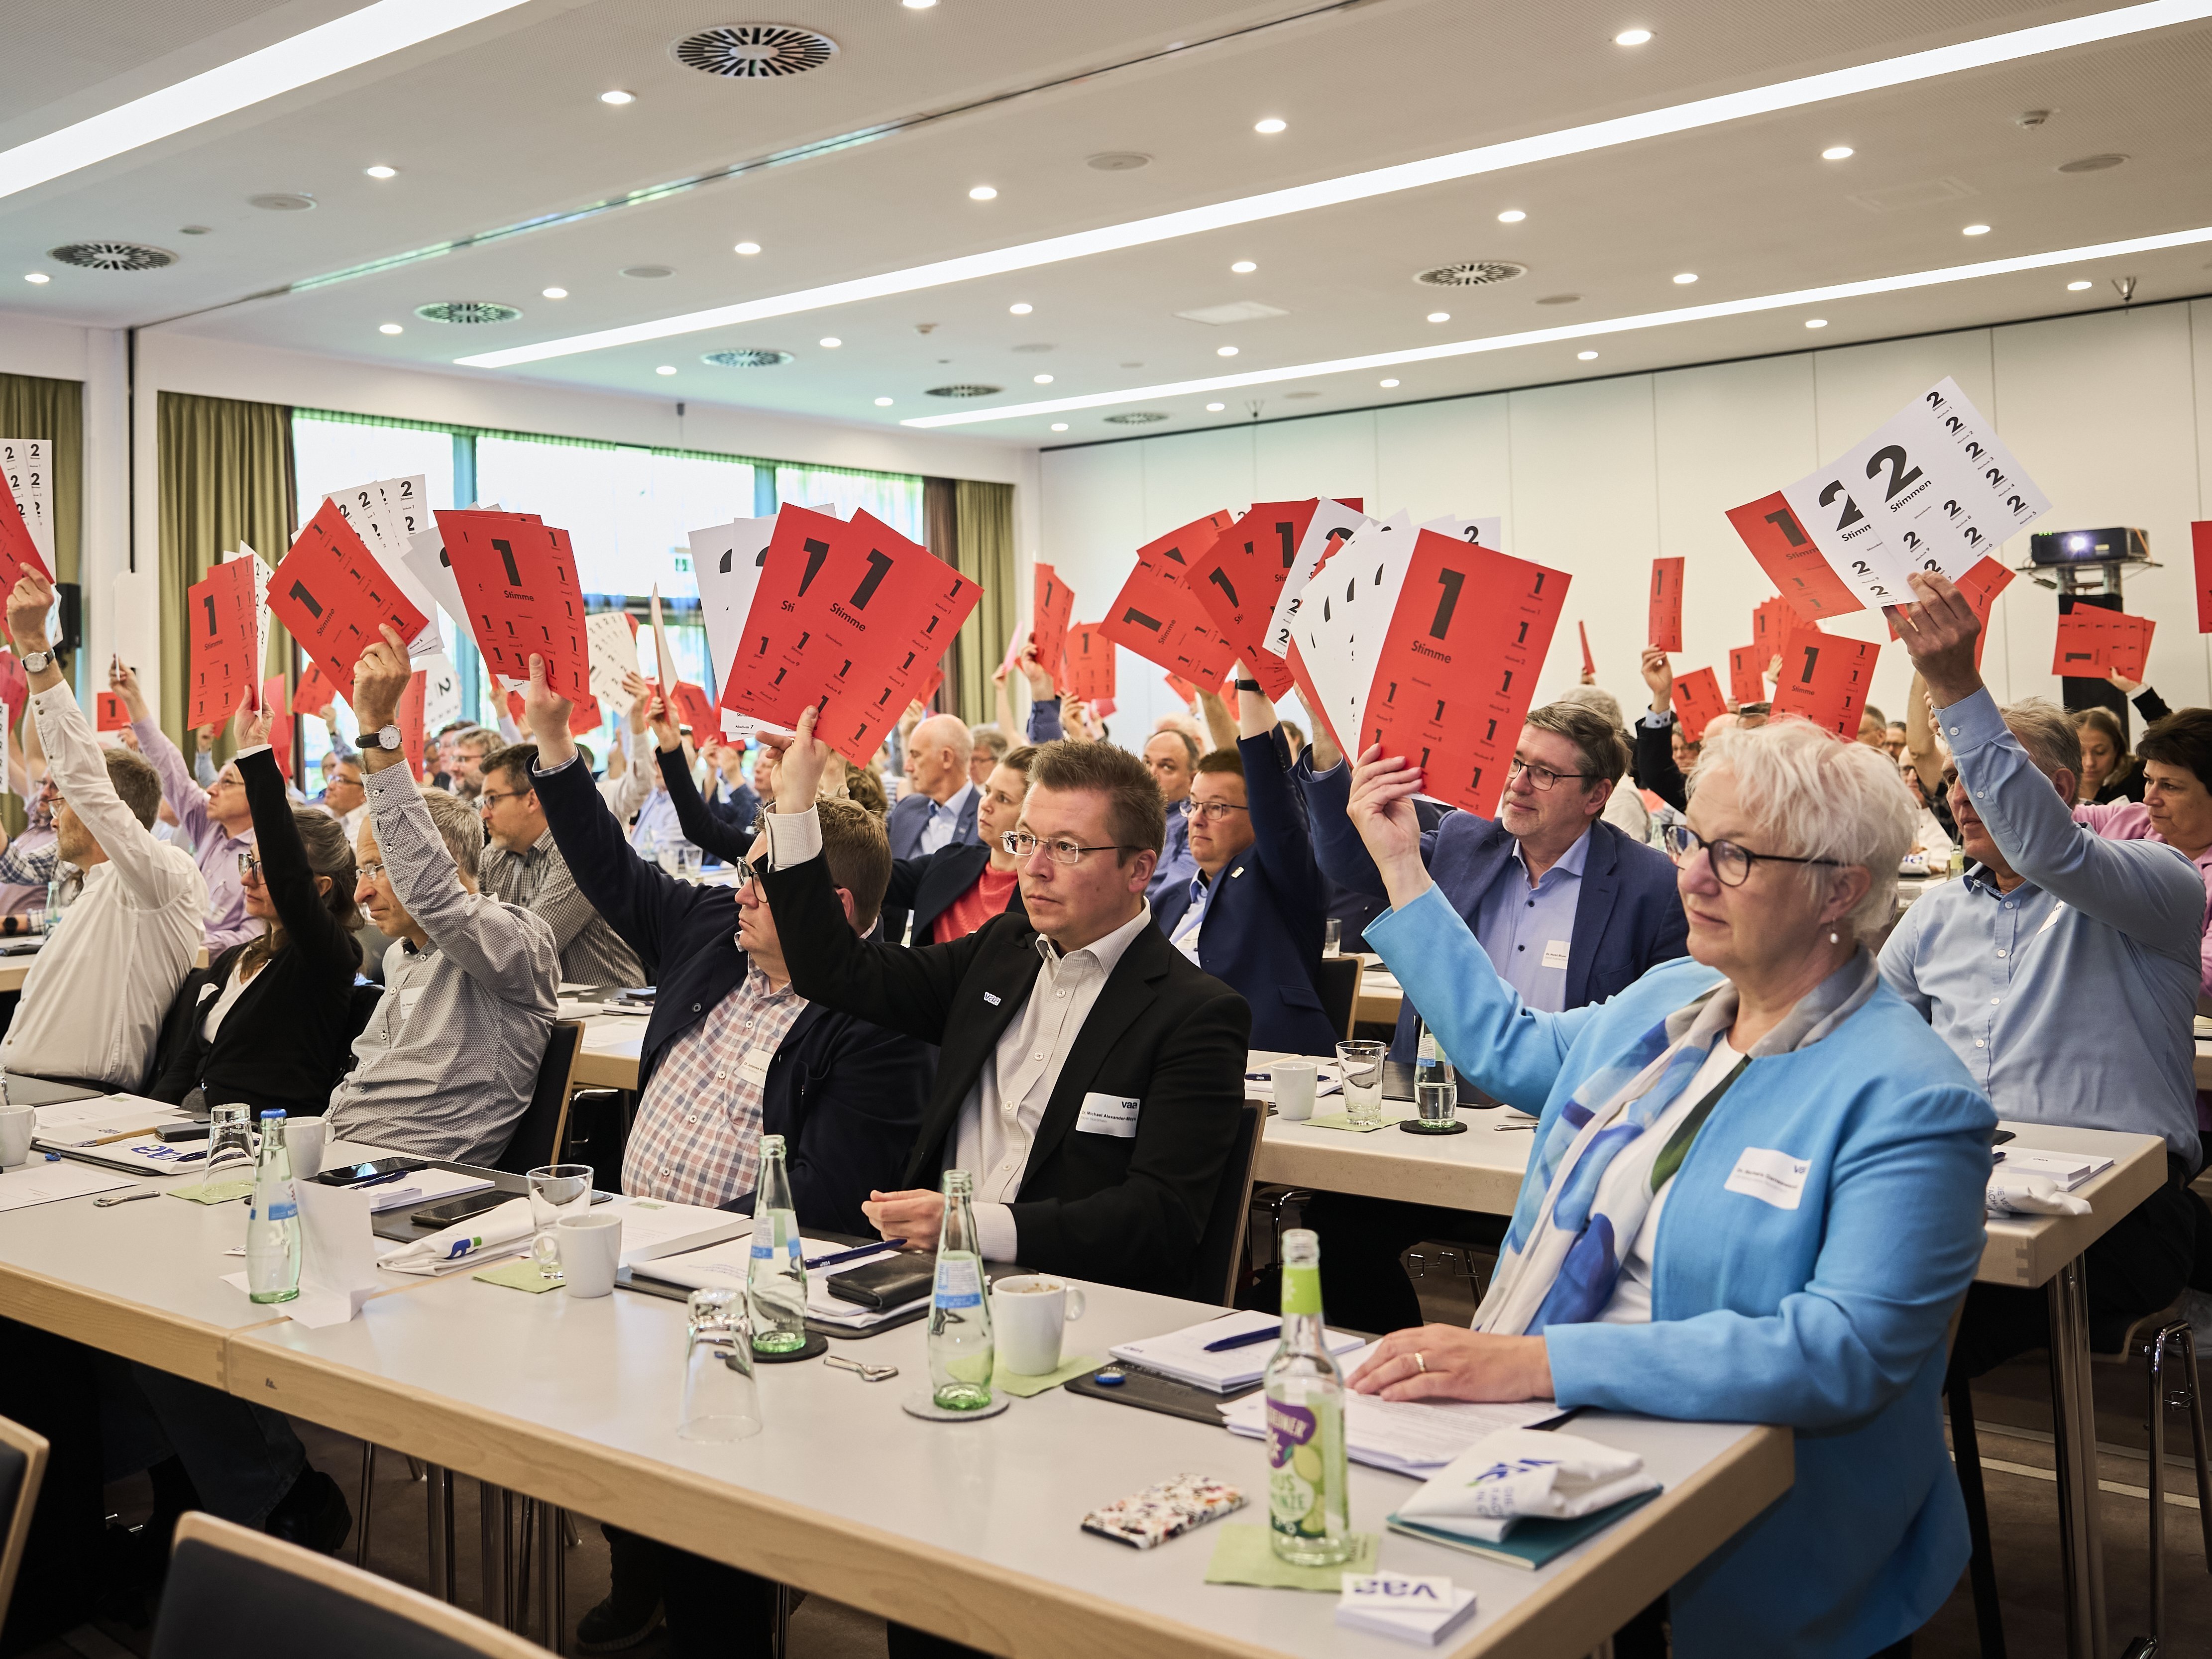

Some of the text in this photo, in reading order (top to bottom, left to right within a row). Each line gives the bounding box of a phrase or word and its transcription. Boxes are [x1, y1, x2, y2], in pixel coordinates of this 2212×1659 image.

[1927, 392, 1944, 408] 2
[1946, 417, 1963, 433] 2
[5, 447, 14, 459] 2
[31, 444, 39, 456] 2
[1966, 442, 1984, 459] 2
[11, 475, 19, 487] 2
[31, 473, 39, 485] 2
[1866, 445, 1923, 503] 2
[1986, 468, 2004, 485] 2
[401, 481, 412, 496] 2
[1890, 480, 1931, 513] Stimmen
[358, 492, 370, 507] 2
[1819, 480, 1864, 532] 2
[2007, 495, 2026, 513] 2
[1944, 500, 1961, 517] 2
[313, 524, 323, 534] 1
[405, 516, 414, 531] 2
[1765, 508, 1807, 547] 1
[549, 532, 556, 546] 1
[1903, 532, 1920, 549] 2
[1965, 527, 1982, 545] 2
[332, 546, 341, 556] 1
[1276, 522, 1294, 568] 1
[491, 539, 522, 586] 1
[1786, 548, 1819, 560] Stimm
[232, 566, 236, 578] 1
[256, 563, 259, 575] 2
[350, 569, 360, 579] 1
[557, 566, 565, 581] 1
[798, 538, 830, 597] 1
[1852, 561, 1870, 574] 2
[1924, 559, 1942, 572] 2
[850, 549, 893, 610] 1
[950, 579, 962, 597] 1
[1209, 567, 1239, 608] 1
[1535, 572, 1545, 594] 1
[1658, 570, 1662, 595] 1
[1792, 578, 1804, 587] 1
[289, 579, 323, 619] 1
[370, 591, 381, 602] 1
[504, 590, 534, 601] Stimme
[1870, 586, 1888, 595] 2
[565, 601, 572, 616] 1
[781, 600, 795, 612] Sti
[1289, 599, 1300, 613] 2
[1430, 568, 1465, 640] 1
[204, 595, 217, 636] 1
[317, 608, 334, 636] Stimme
[391, 615, 404, 627] 1
[830, 603, 866, 632] Stimme
[1123, 607, 1162, 632] 1
[350, 624, 359, 635] 1
[506, 621, 514, 635] 1
[542, 626, 549, 640] 1
[926, 616, 939, 633] 1
[1158, 620, 1176, 645] Stimme
[1518, 622, 1528, 643] 1
[797, 632, 810, 650] 1
[1083, 633, 1088, 653] 1
[1278, 629, 1289, 643] 2
[205, 639, 223, 651] Stimme
[760, 637, 769, 655] 1
[1411, 641, 1451, 664] Stimme
[1860, 645, 1865, 656] 1
[903, 652, 915, 669] 1
[1801, 647, 1819, 683] 1
[2066, 653, 2091, 662] 1
[224, 664, 228, 675] 1
[550, 660, 554, 674] 1
[839, 660, 852, 677] 1
[1853, 670, 1858, 681] 1
[774, 667, 787, 685] 1
[1502, 670, 1512, 692] 1
[225, 693, 228, 704] 1
[879, 687, 891, 705] 1
[1388, 682, 1397, 702] 1
[1679, 683, 1690, 700] 1
[1792, 685, 1815, 695] Stimme
[108, 700, 115, 717] 1
[1846, 696, 1851, 707] 1
[1435, 700, 1444, 721] 1
[855, 723, 867, 741] 1
[1487, 719, 1497, 740] 1
[1420, 748, 1430, 768] 1
[1472, 767, 1481, 788] 1
[985, 993, 1000, 1004] vaa
[1354, 1579, 1438, 1599] vaa
